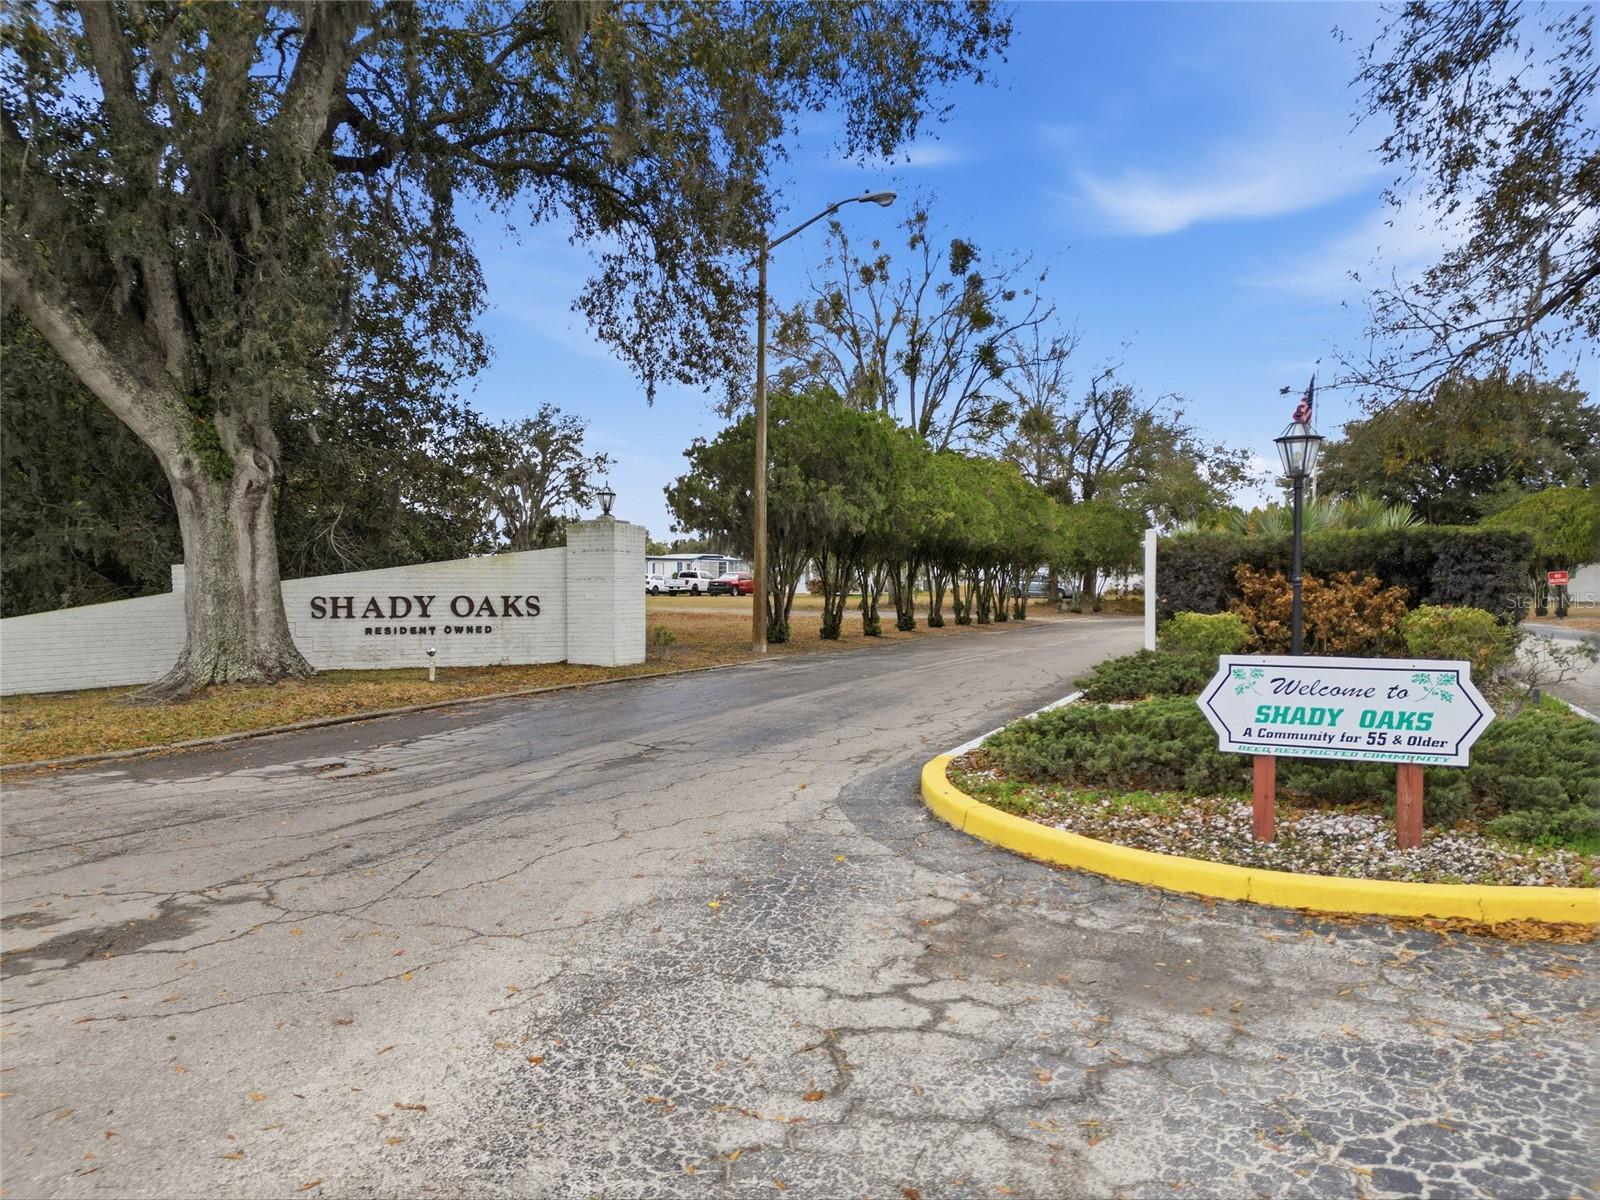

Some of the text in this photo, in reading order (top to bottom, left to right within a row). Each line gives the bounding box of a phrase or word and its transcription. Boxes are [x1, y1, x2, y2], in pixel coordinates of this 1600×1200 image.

[310, 595, 541, 619] SHADY OAKS
[365, 625, 493, 636] RESIDENT OWNED
[1270, 677, 1409, 699] Welcome to
[1254, 704, 1434, 731] SHADY OAKS
[1243, 728, 1448, 748] A Community for 55 & Older
[1274, 747, 1359, 757] RESTRICTED
[1363, 752, 1451, 762] COMMUNITY
